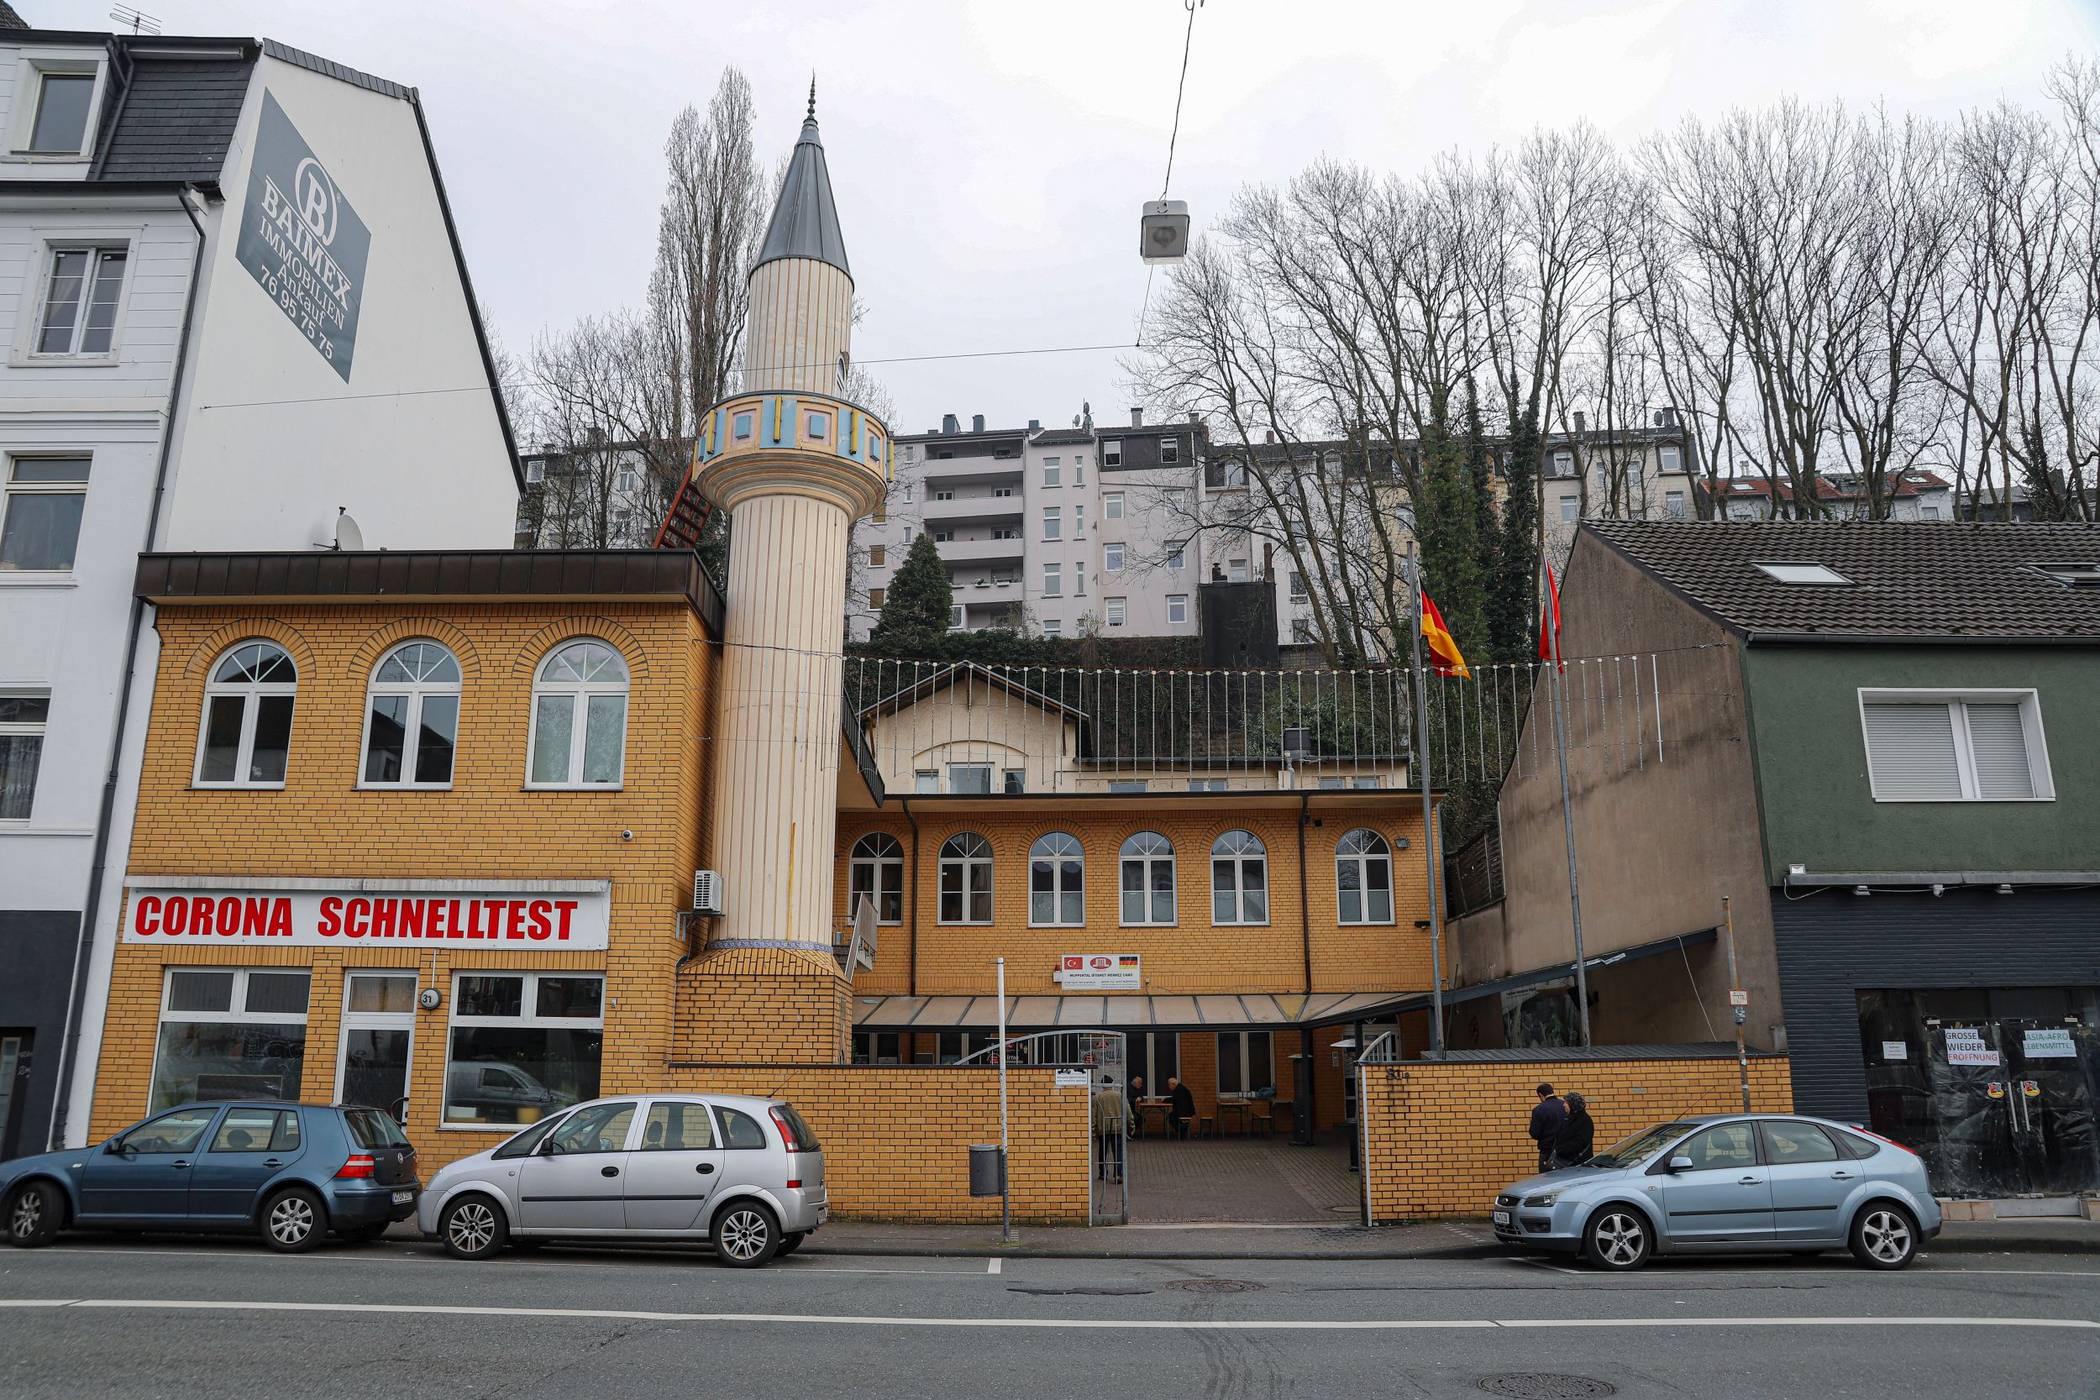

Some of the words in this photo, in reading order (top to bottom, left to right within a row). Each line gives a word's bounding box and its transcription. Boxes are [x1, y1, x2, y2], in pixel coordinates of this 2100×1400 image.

[258, 214, 345, 331] IMMOBILIEN
[261, 179, 352, 311] BAIMEX
[259, 264, 279, 296] 76
[280, 292, 298, 319] 95
[300, 310, 316, 340] 75
[318, 330, 334, 360] 75
[277, 263, 327, 328] Ankauf
[135, 895, 293, 937] CORONA
[317, 896, 579, 941] SCHNELLTEST
[423, 994, 431, 1003] 31
[1945, 1032, 1977, 1040] GROSSE
[1947, 1042, 1983, 1051] WIEDER
